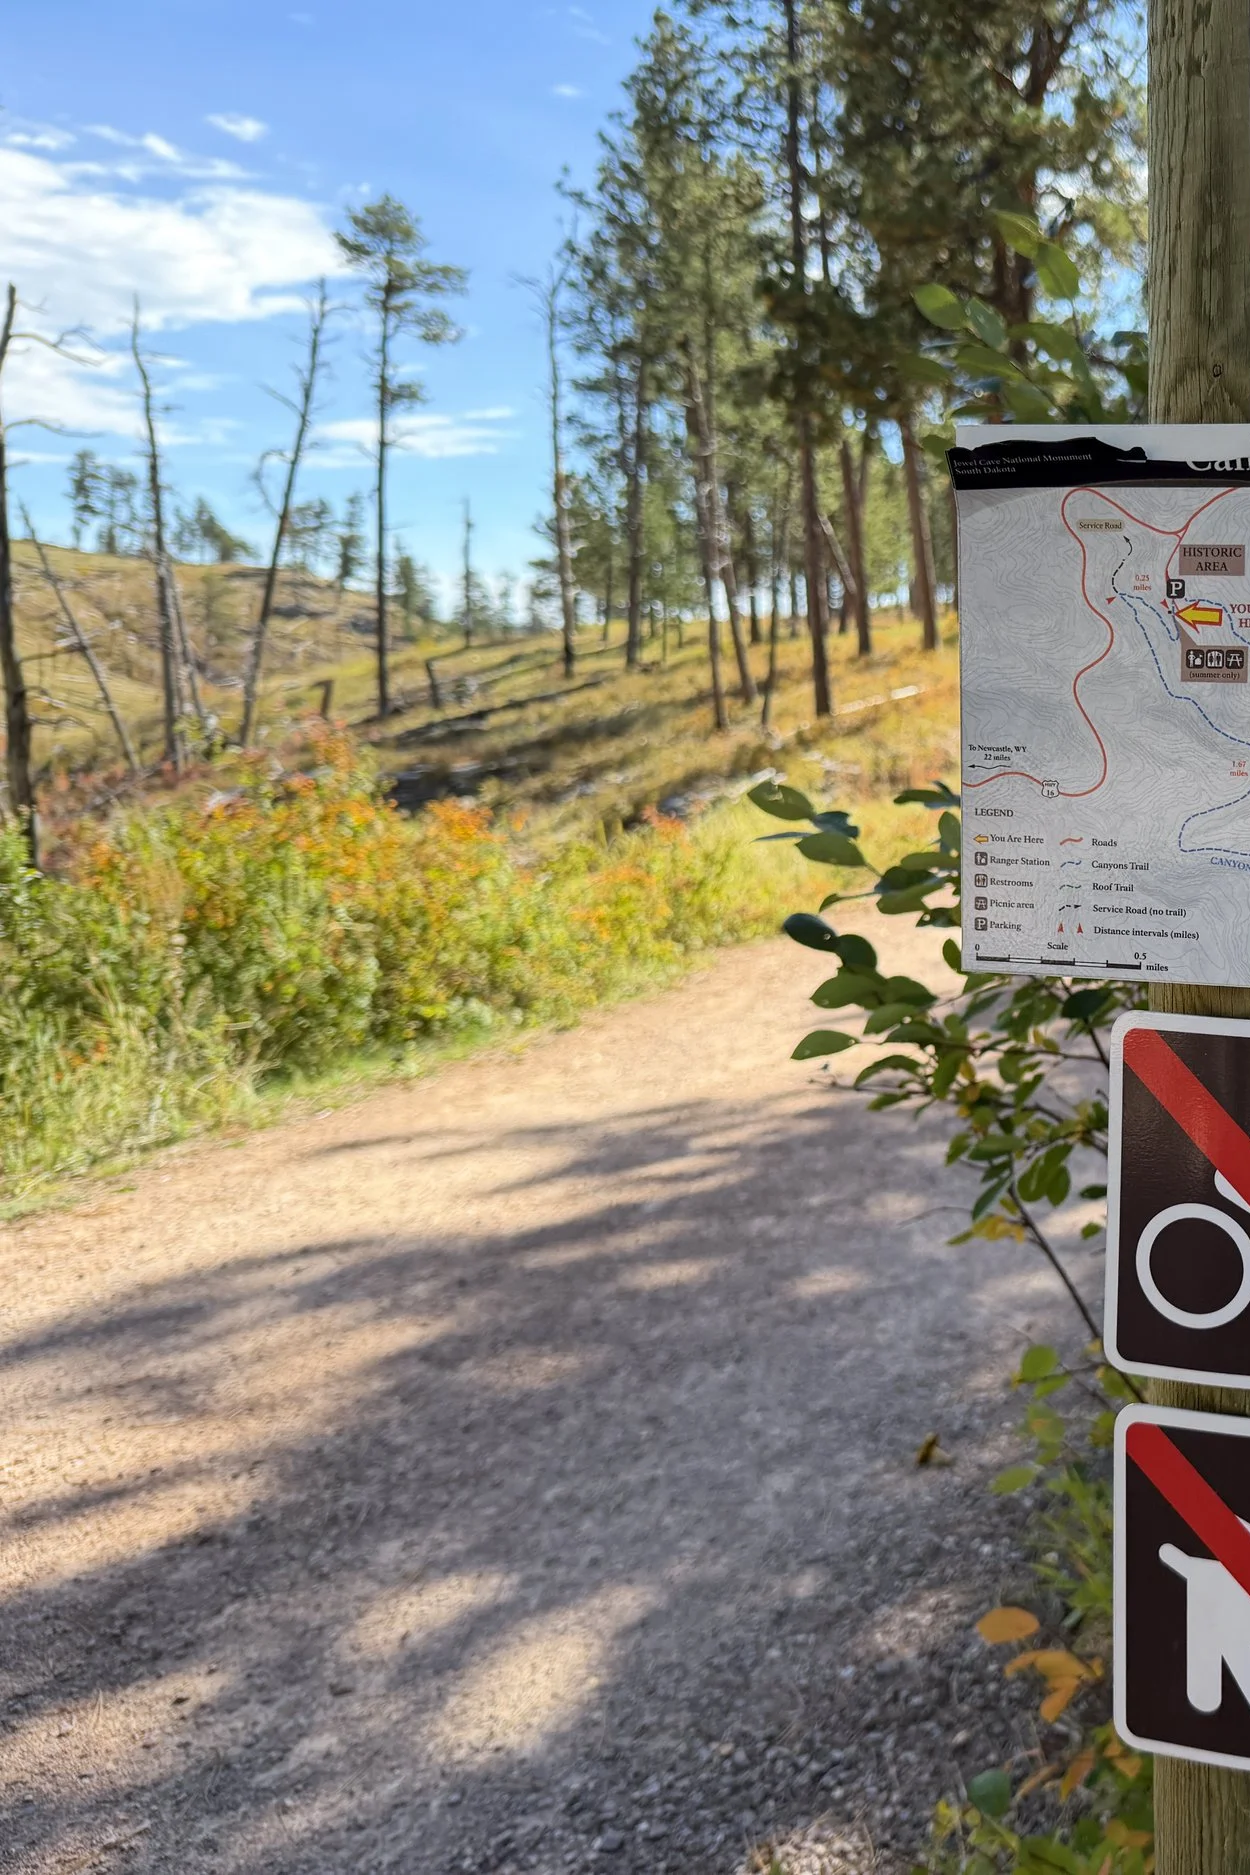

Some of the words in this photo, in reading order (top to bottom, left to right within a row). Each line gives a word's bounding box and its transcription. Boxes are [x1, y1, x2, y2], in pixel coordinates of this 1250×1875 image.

[953, 459, 977, 467] Jewel
[1002, 456, 1041, 465] National
[1043, 453, 1092, 462] Monument
[955, 466, 982, 475] South
[983, 466, 1016, 474] Dakota
[1183, 547, 1242, 557] HISTORIC
[1196, 562, 1228, 571] AREA
[1170, 582, 1182, 596] P
[977, 745, 1013, 753] Newcastle,
[1229, 769, 1248, 777] miles
[975, 808, 1014, 817] LEGEND
[990, 834, 1005, 842] You
[1007, 835, 1022, 843] Are
[1024, 835, 1044, 844] Here
[1091, 838, 1117, 847] Roads
[990, 856, 1019, 867] Ranger
[1021, 857, 1050, 867] Station
[1091, 860, 1128, 871] Canyons
[1129, 862, 1149, 871] Trail
[990, 878, 1034, 888] Restrooms
[1092, 883, 1113, 891] Roof
[1114, 883, 1134, 892] Trail
[990, 900, 1015, 908] Picnic
[1093, 905, 1123, 914] Service
[1125, 906, 1147, 915] Road
[1149, 907, 1164, 917] (no
[1165, 908, 1187, 918] trail)
[989, 921, 1022, 931] Parking
[1094, 926, 1130, 936] Distance
[1132, 927, 1168, 938] intervals
[1170, 929, 1199, 940] (miles)
[975, 943, 980, 951] 0
[1047, 941, 1069, 950] Scale
[1134, 952, 1147, 960] 0.5
[1146, 963, 1169, 971] miles
